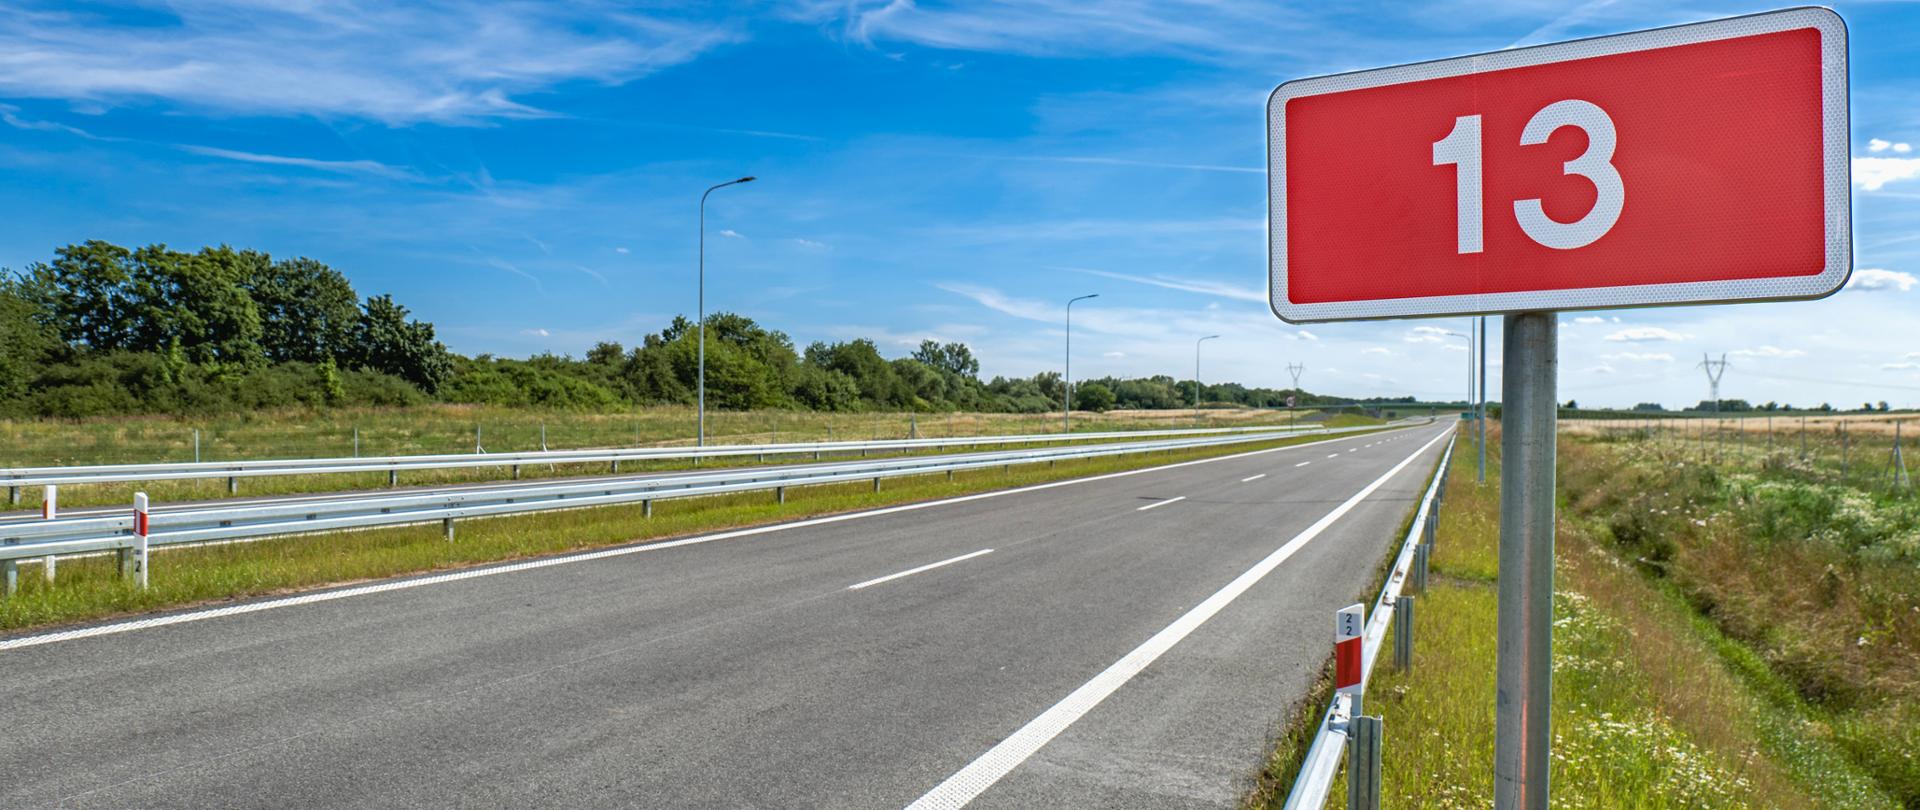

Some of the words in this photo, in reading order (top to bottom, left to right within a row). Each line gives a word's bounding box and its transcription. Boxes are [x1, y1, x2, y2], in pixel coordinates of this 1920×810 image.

[1433, 99, 1625, 253] 13
[1346, 613, 1352, 623] 2
[1346, 626, 1352, 636] 2
